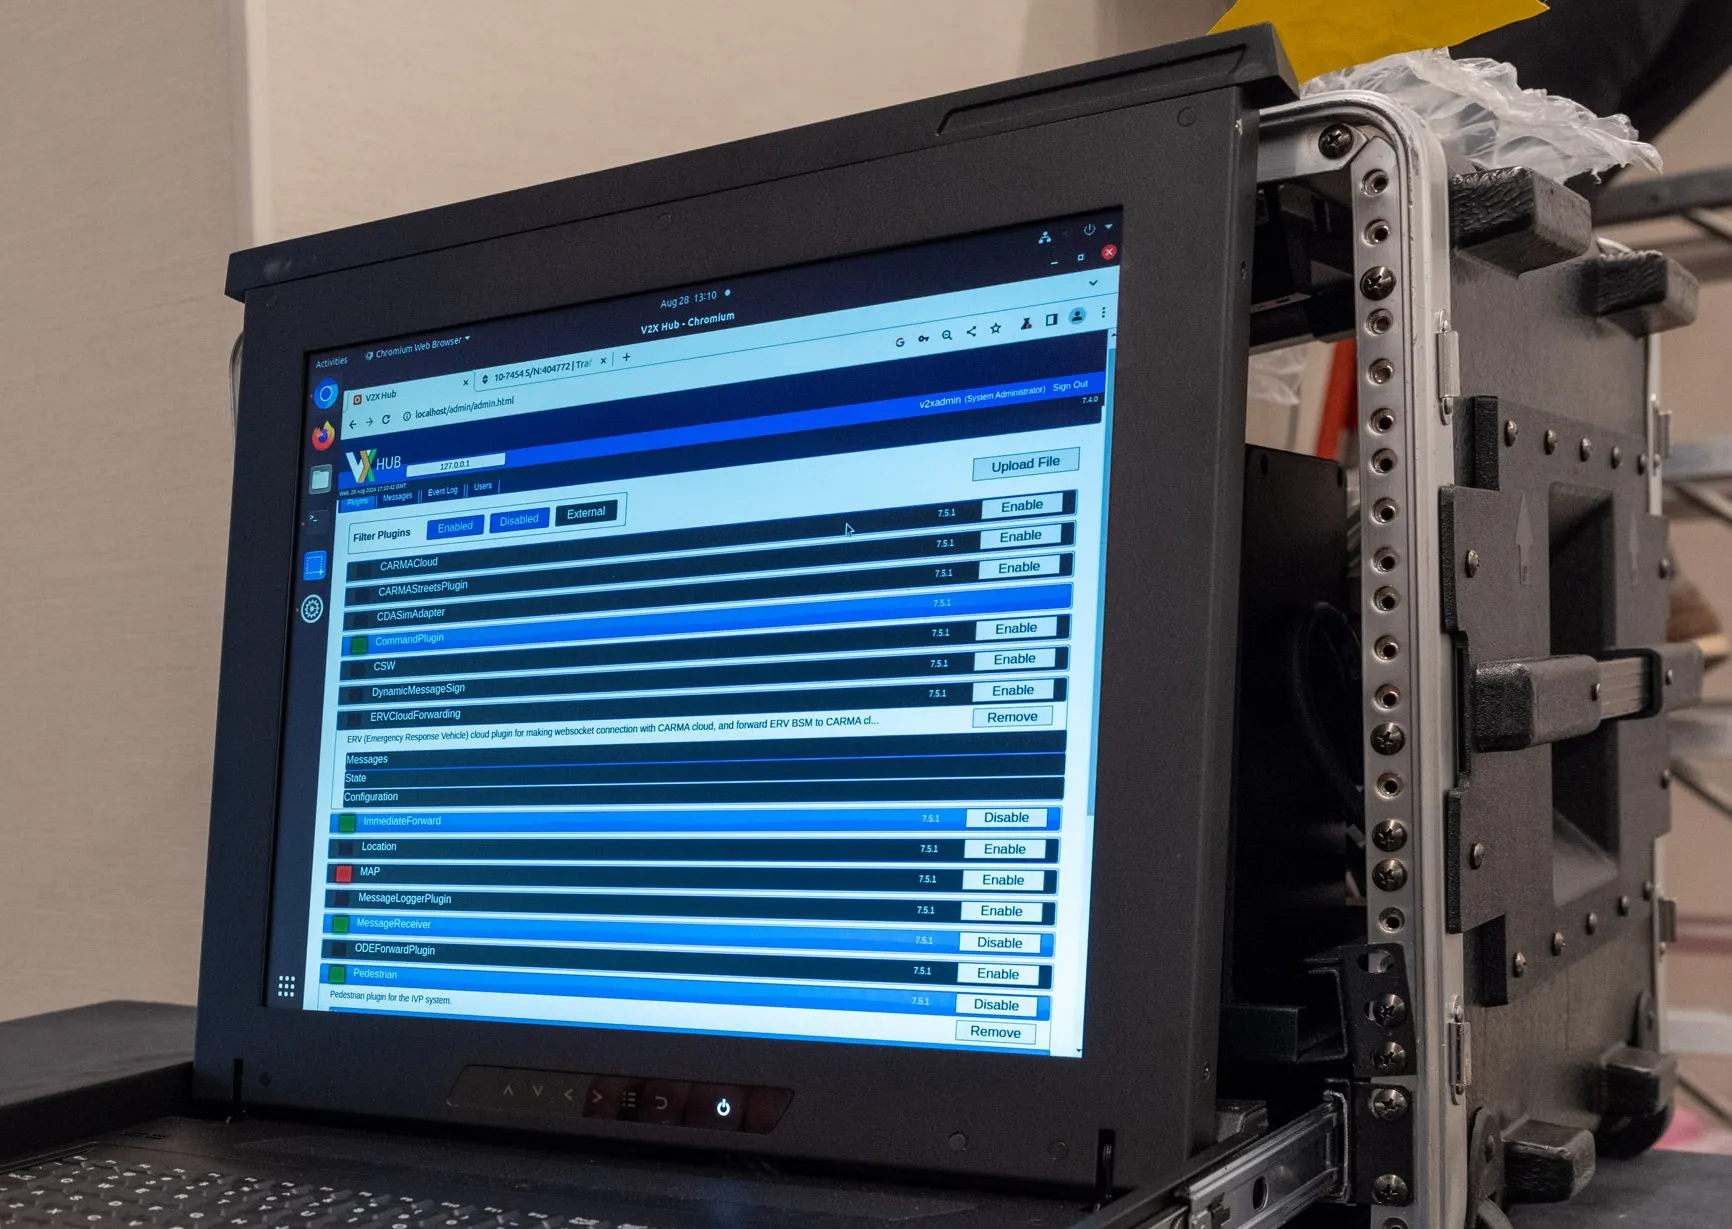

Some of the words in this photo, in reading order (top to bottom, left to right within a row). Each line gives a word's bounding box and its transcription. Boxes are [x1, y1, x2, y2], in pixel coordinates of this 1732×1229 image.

[660, 298, 678, 309] Aug
[679, 295, 689, 305] 28
[694, 291, 717, 303] 13:10
[641, 323, 659, 335] V2X
[662, 320, 679, 332] Hub
[687, 312, 735, 327] Chromium
[375, 344, 413, 359] Chromium
[414, 342, 431, 351] Web
[432, 336, 462, 348] Browser
[316, 356, 348, 368] Activities
[495, 368, 524, 382] 10-7454
[525, 361, 570, 378] S/N:404772
[1053, 382, 1071, 393] Sign
[1073, 380, 1088, 389] Out
[366, 392, 380, 401] V2X
[382, 390, 396, 400] Hub
[919, 397, 962, 409] v2xadmin
[964, 391, 994, 404] (System
[995, 385, 1046, 399] Administrator)
[415, 396, 514, 419] localhost/admin/admin.html
[376, 456, 401, 470] HUB
[440, 460, 470, 471] 127.0.0.1
[992, 458, 1034, 474] Upload
[1038, 456, 1060, 468] File
[428, 487, 445, 497] Event
[446, 485, 458, 496] Log
[474, 481, 492, 491] Users
[347, 498, 368, 507] Plugins
[383, 492, 412, 502] Messages
[1001, 499, 1043, 513] Enable
[567, 506, 606, 519] External
[938, 508, 956, 517] 7.5.1
[500, 513, 539, 527] Disabled
[438, 520, 473, 534] Enabled
[353, 532, 375, 542] Filter
[377, 528, 411, 540] Plugins
[1000, 529, 1042, 543] Enable
[936, 539, 954, 548] 7.5.1
[380, 557, 439, 571] CARMACloud
[998, 561, 1041, 574] Enable
[935, 568, 953, 578] 7.5.1
[378, 580, 468, 597] CARMAStreetsPlugin
[933, 598, 951, 607] 7.5.1
[376, 607, 445, 621] CDASimAdapter
[932, 628, 950, 637] 7.5.1
[995, 622, 1038, 635] Enable
[375, 633, 444, 646] CommandPlugin
[930, 659, 948, 668] 7.5.1
[994, 653, 1036, 665] Enable
[373, 661, 396, 671] CSW
[372, 683, 465, 698] DynamicMessageSign
[929, 689, 947, 698] 7.5.1
[992, 684, 1035, 696] Enable
[370, 709, 461, 722] ERVCloudForwarding
[987, 711, 1038, 723] Remove
[347, 735, 363, 743] ERV
[363, 733, 403, 744] (Emergency
[405, 732, 439, 743] Response
[441, 730, 469, 740] Vehicle)
[470, 730, 489, 739] cloud
[491, 728, 513, 739] plugin
[514, 729, 524, 737] for
[526, 727, 553, 738] making
[554, 726, 595, 736] websocket
[596, 725, 638, 734] connection
[639, 723, 656, 733] with
[657, 722, 691, 732] CARMA
[691, 721, 716, 732] cloud,
[718, 720, 734, 730] and
[736, 719, 768, 729] forward
[769, 719, 790, 728] ERV
[792, 718, 813, 728] BSM
[815, 718, 824, 727] to
[826, 716, 862, 726] CARMA
[346, 754, 389, 766] Messages
[345, 773, 367, 783] State
[343, 791, 399, 803] Configuration
[363, 816, 442, 826] ImmediateForward
[922, 814, 940, 823] 7.5.1
[984, 811, 1029, 823] Disable
[361, 841, 397, 851] Location
[920, 844, 939, 853] 7.5.1
[984, 843, 1026, 855] Enable
[360, 866, 381, 876] MAP
[918, 874, 937, 884] 7.5.1
[982, 873, 1025, 886] Enable
[358, 892, 452, 905] MessageLoggerPlugin
[917, 906, 935, 915] 7.5.1
[981, 905, 1023, 917] Enable
[356, 918, 431, 929] MessageReceiver
[915, 936, 933, 945] 7.5.1
[977, 936, 1023, 949] Disable
[354, 943, 436, 957] ODEForwardPlugin
[353, 968, 397, 979] Pedestrian
[913, 966, 932, 976] 7.5.1
[977, 967, 1020, 980] Enable
[330, 990, 365, 999] Pedestrian
[366, 992, 387, 1003] plugin
[387, 993, 397, 1001] for
[398, 993, 410, 1001] the
[411, 994, 424, 1003] IVP
[425, 996, 452, 1005] system.
[912, 996, 930, 1006] 7.5.1
[974, 998, 1020, 1011] Disable
[970, 1025, 1022, 1039] Remove
